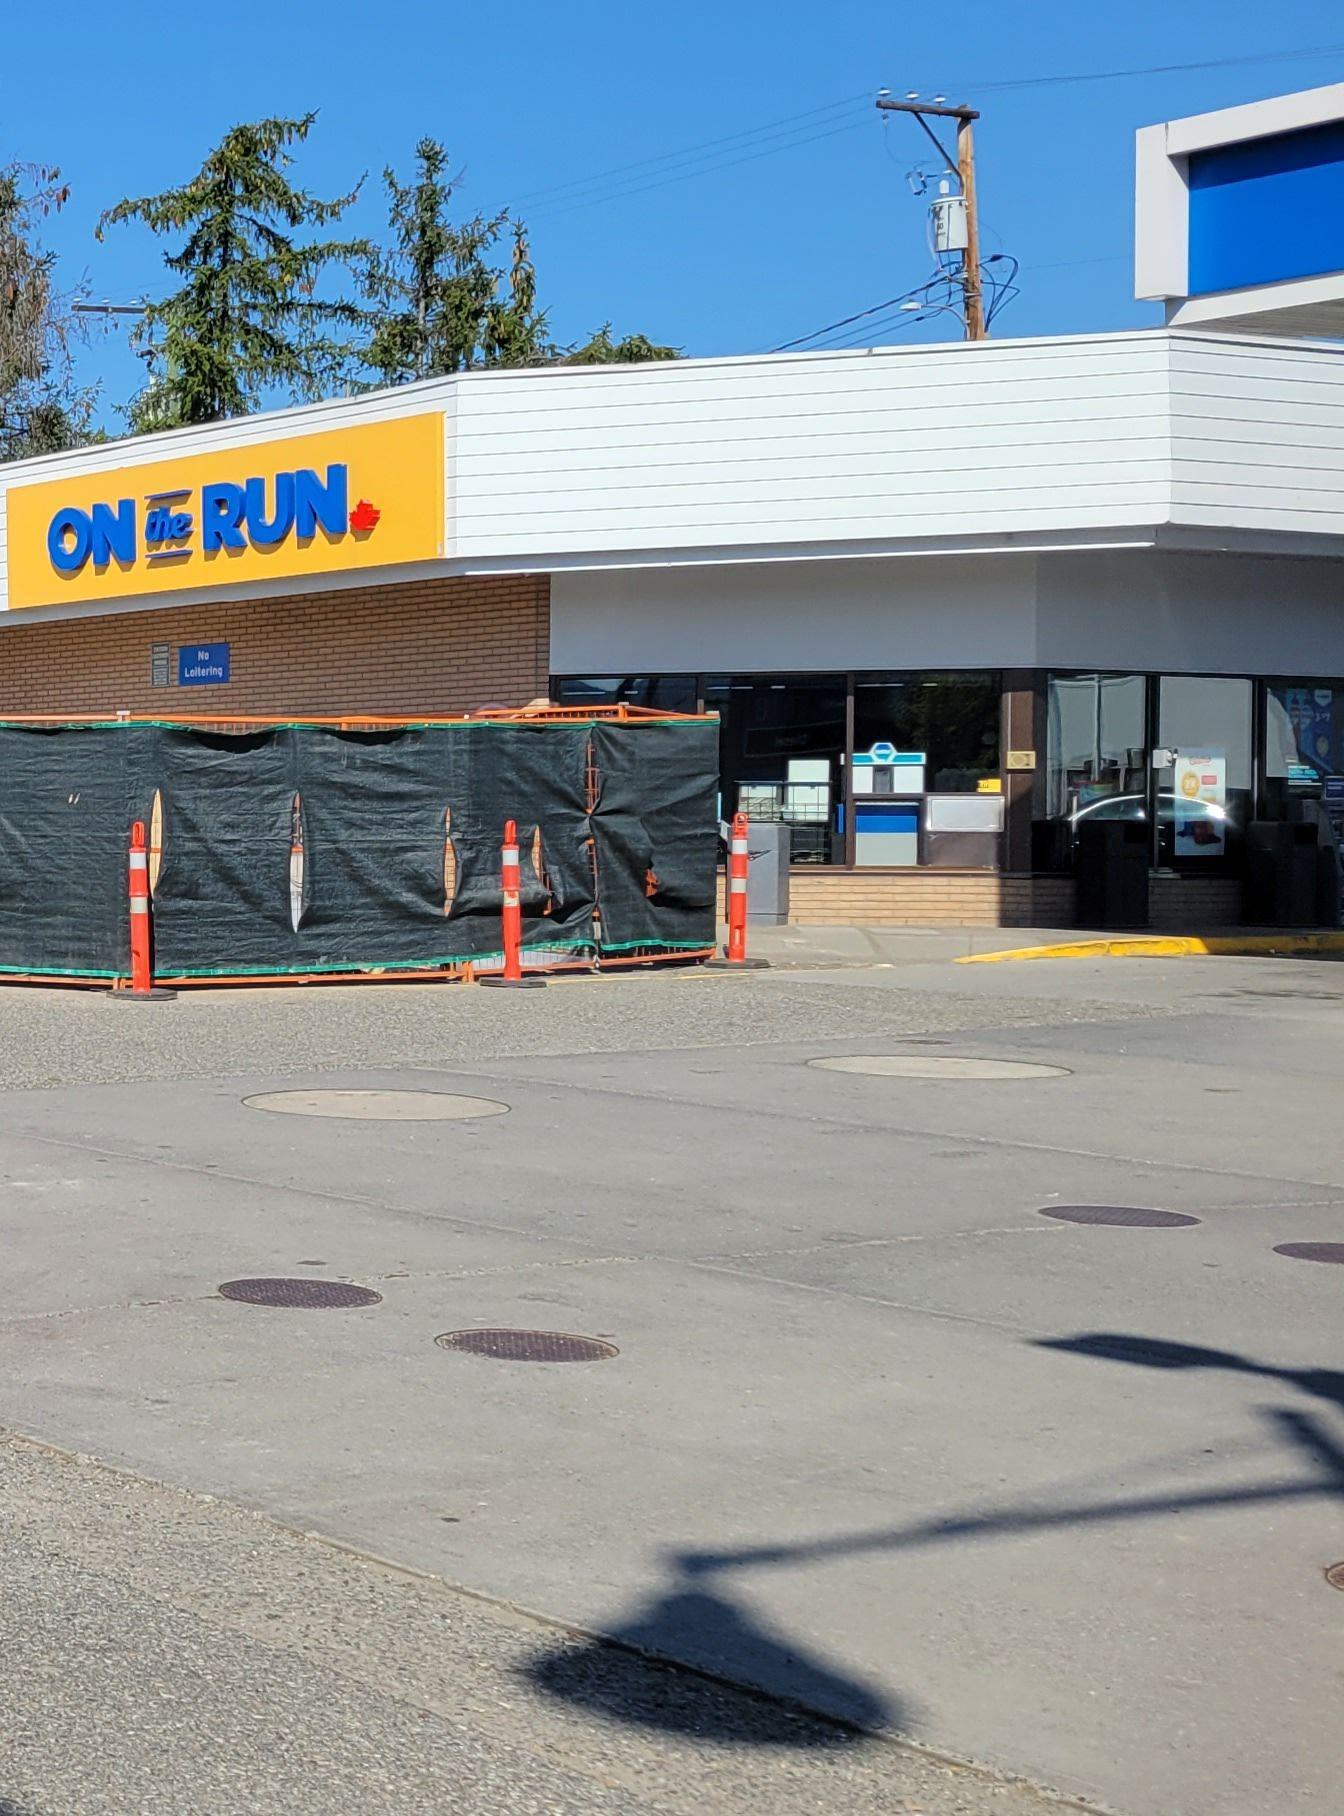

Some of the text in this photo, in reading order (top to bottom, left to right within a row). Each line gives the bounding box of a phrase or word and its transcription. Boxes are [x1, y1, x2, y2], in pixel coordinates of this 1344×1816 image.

[47, 463, 348, 572] ON the RUN
[197, 650, 210, 662] No
[184, 665, 223, 678] Loitering
